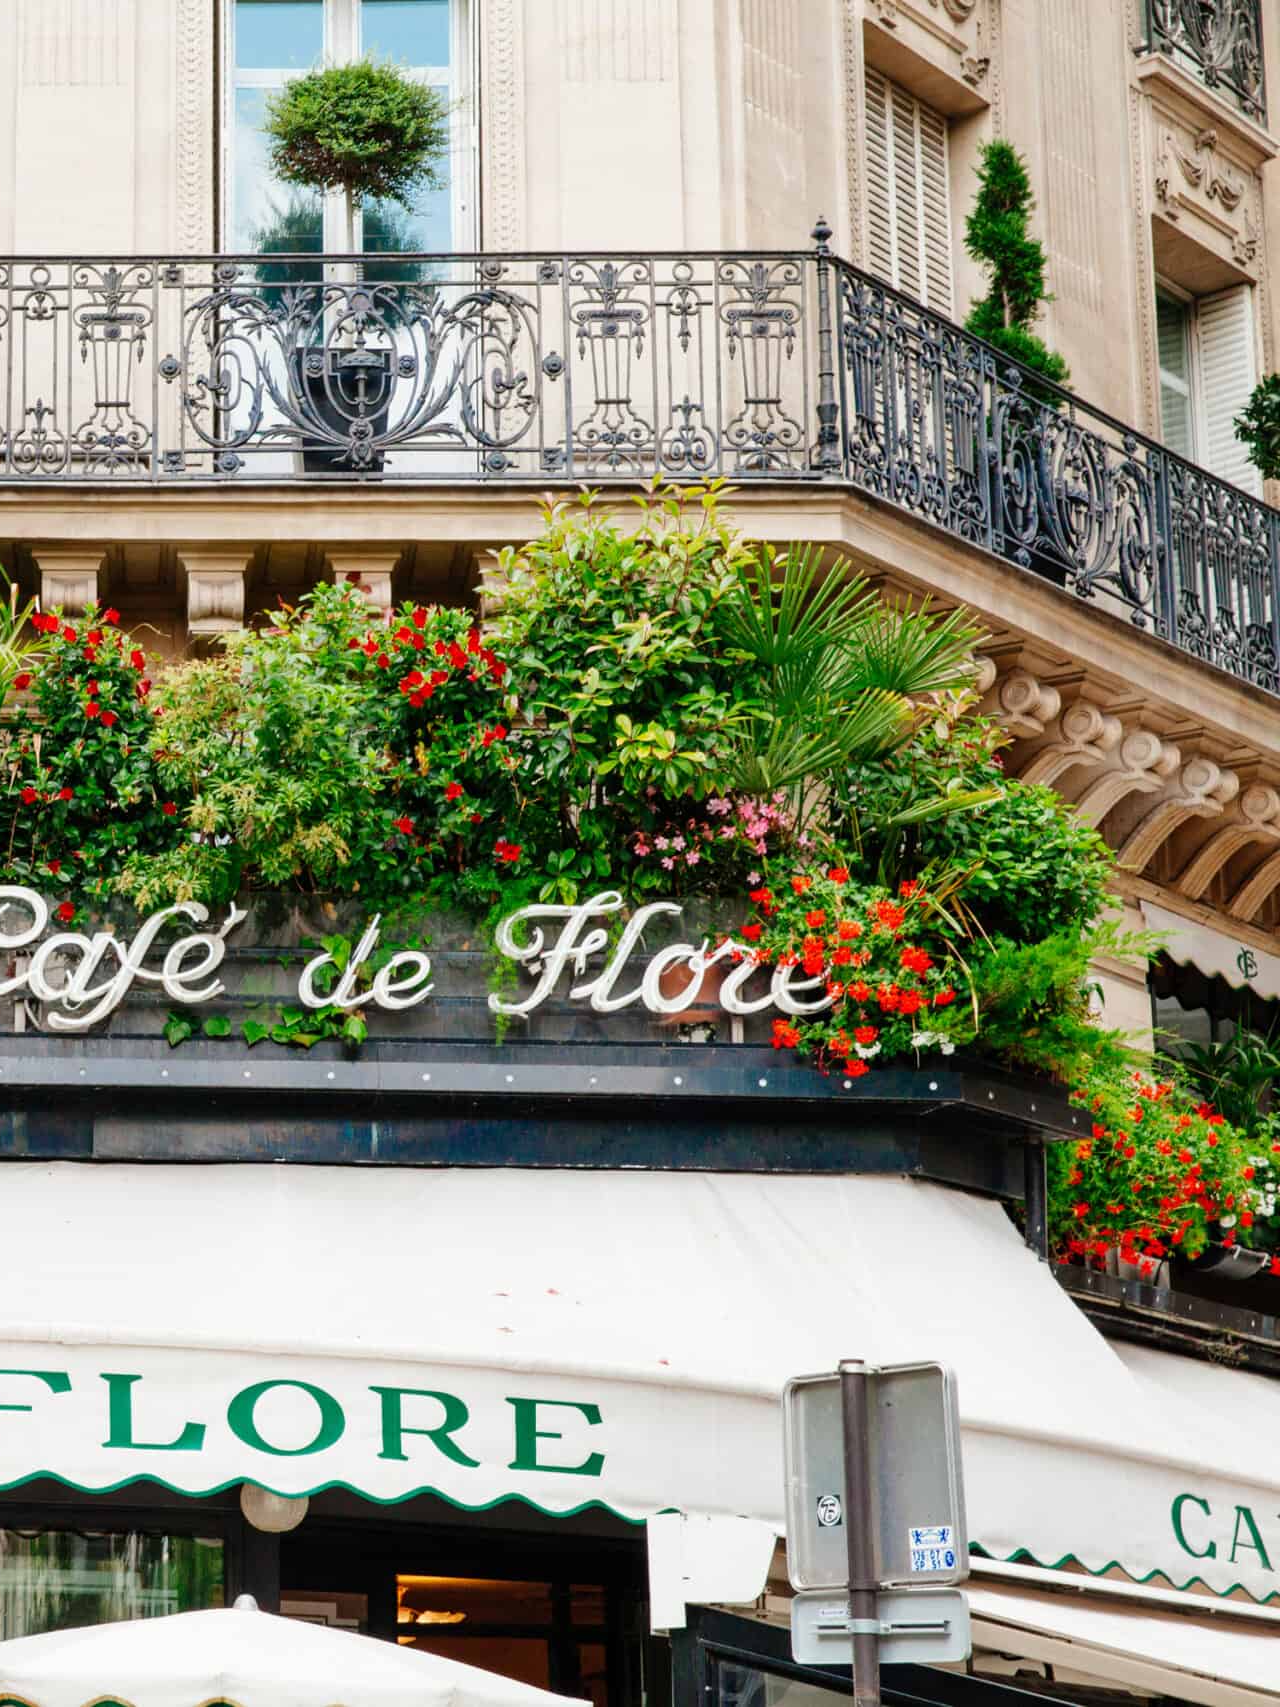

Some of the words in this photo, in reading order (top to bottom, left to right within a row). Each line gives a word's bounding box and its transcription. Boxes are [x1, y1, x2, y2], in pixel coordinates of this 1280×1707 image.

[298, 912, 434, 1011] de
[488, 890, 837, 1020] Flore
[1171, 1493, 1280, 1572] CA
